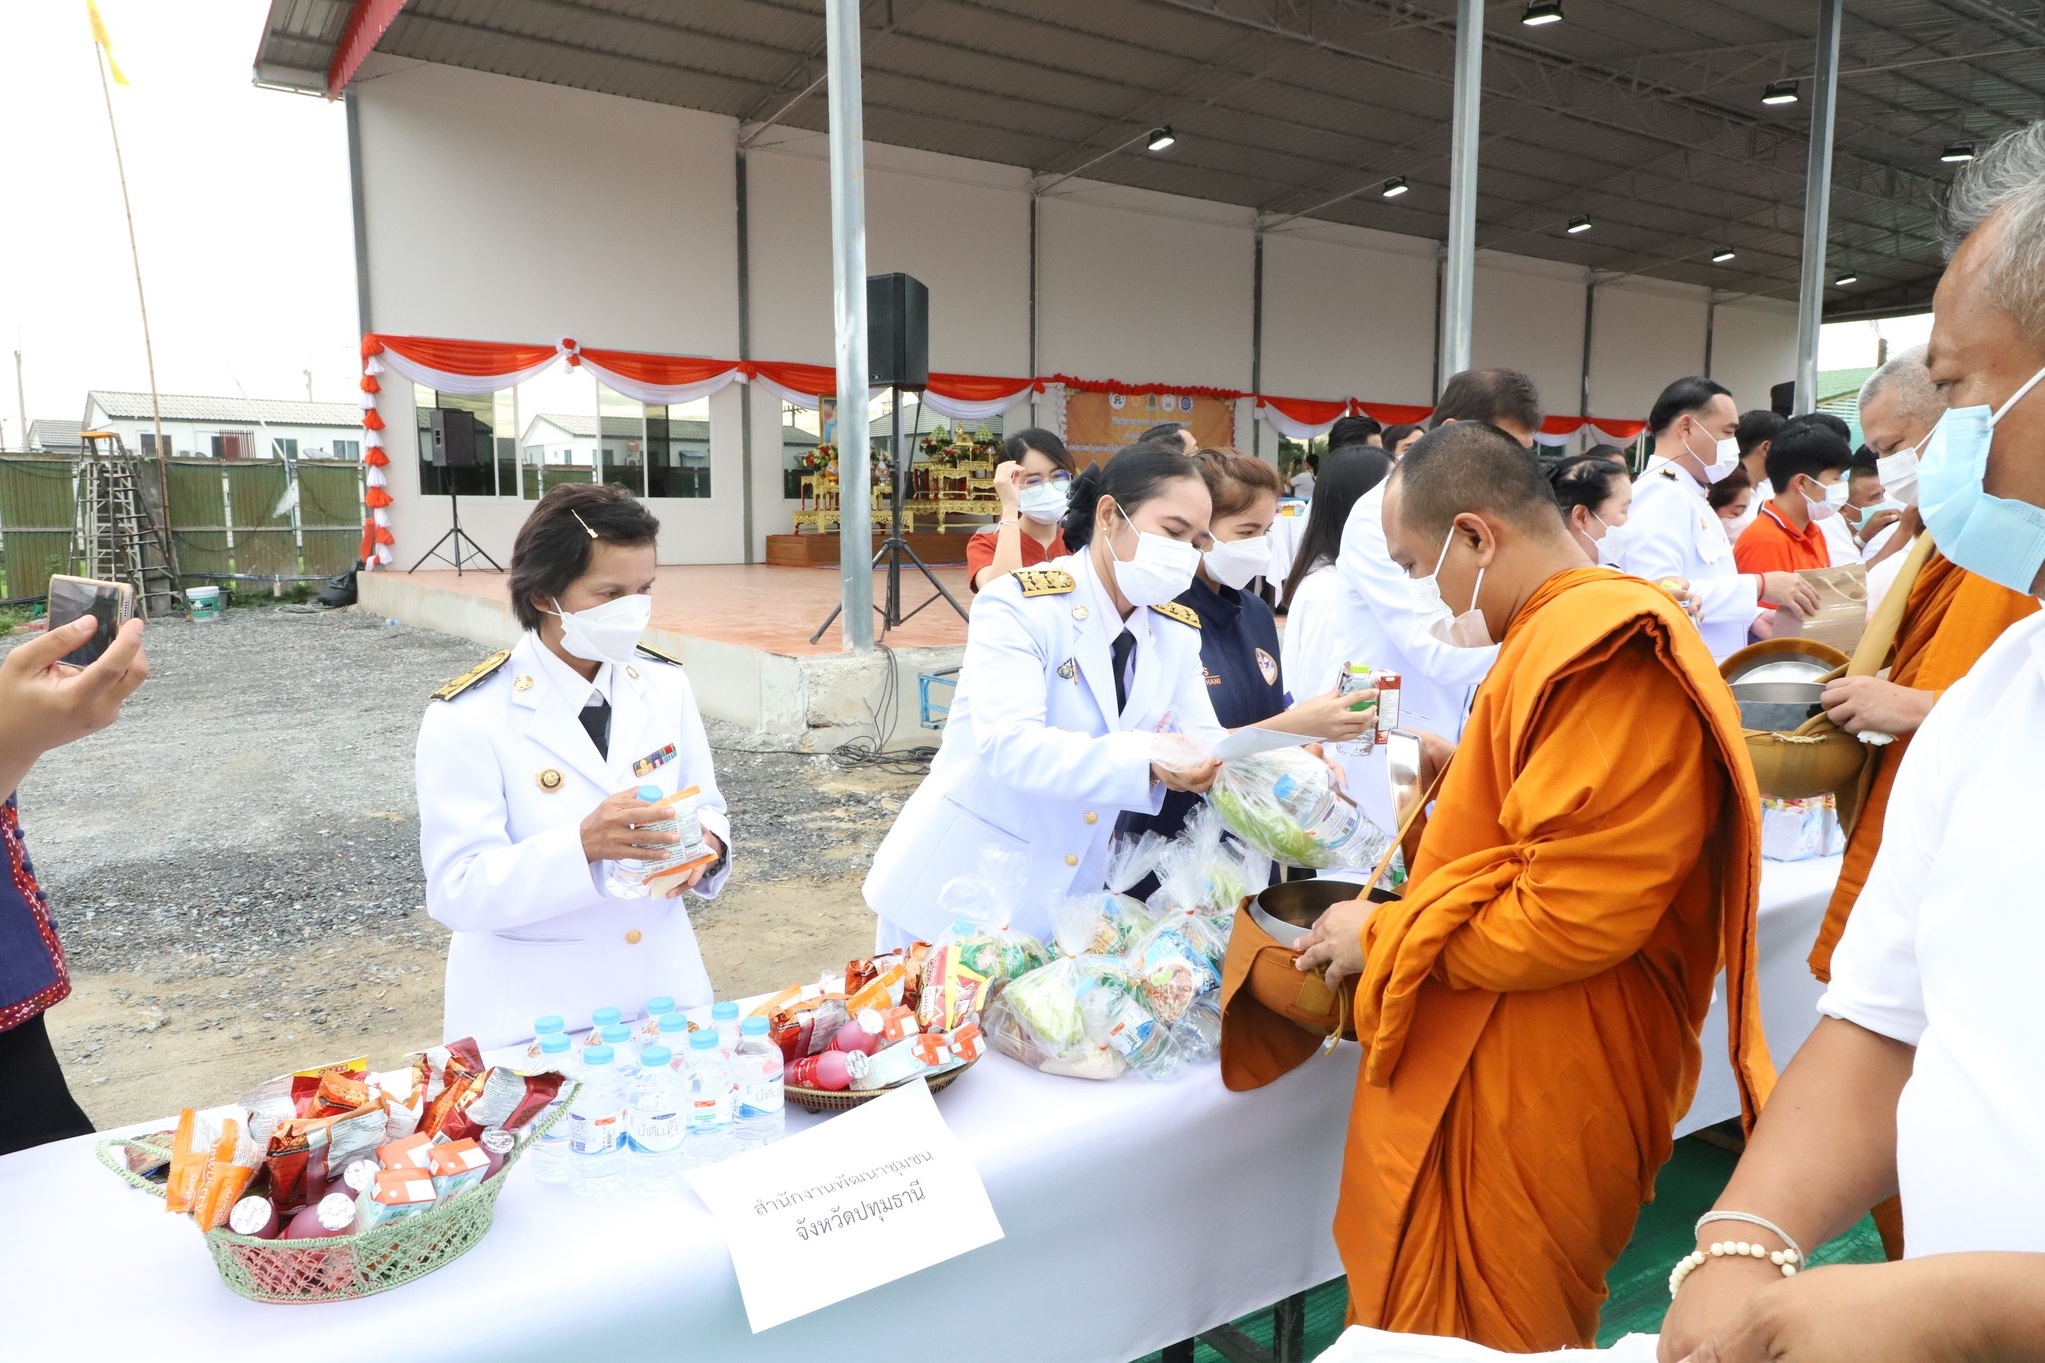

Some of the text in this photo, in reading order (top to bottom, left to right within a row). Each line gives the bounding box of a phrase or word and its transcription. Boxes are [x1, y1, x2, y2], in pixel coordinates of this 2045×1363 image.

[754, 1150, 934, 1216] สำนักงานพัฒนาชุมชน
[795, 1179, 926, 1241] จังหวัดปทุมธานี
